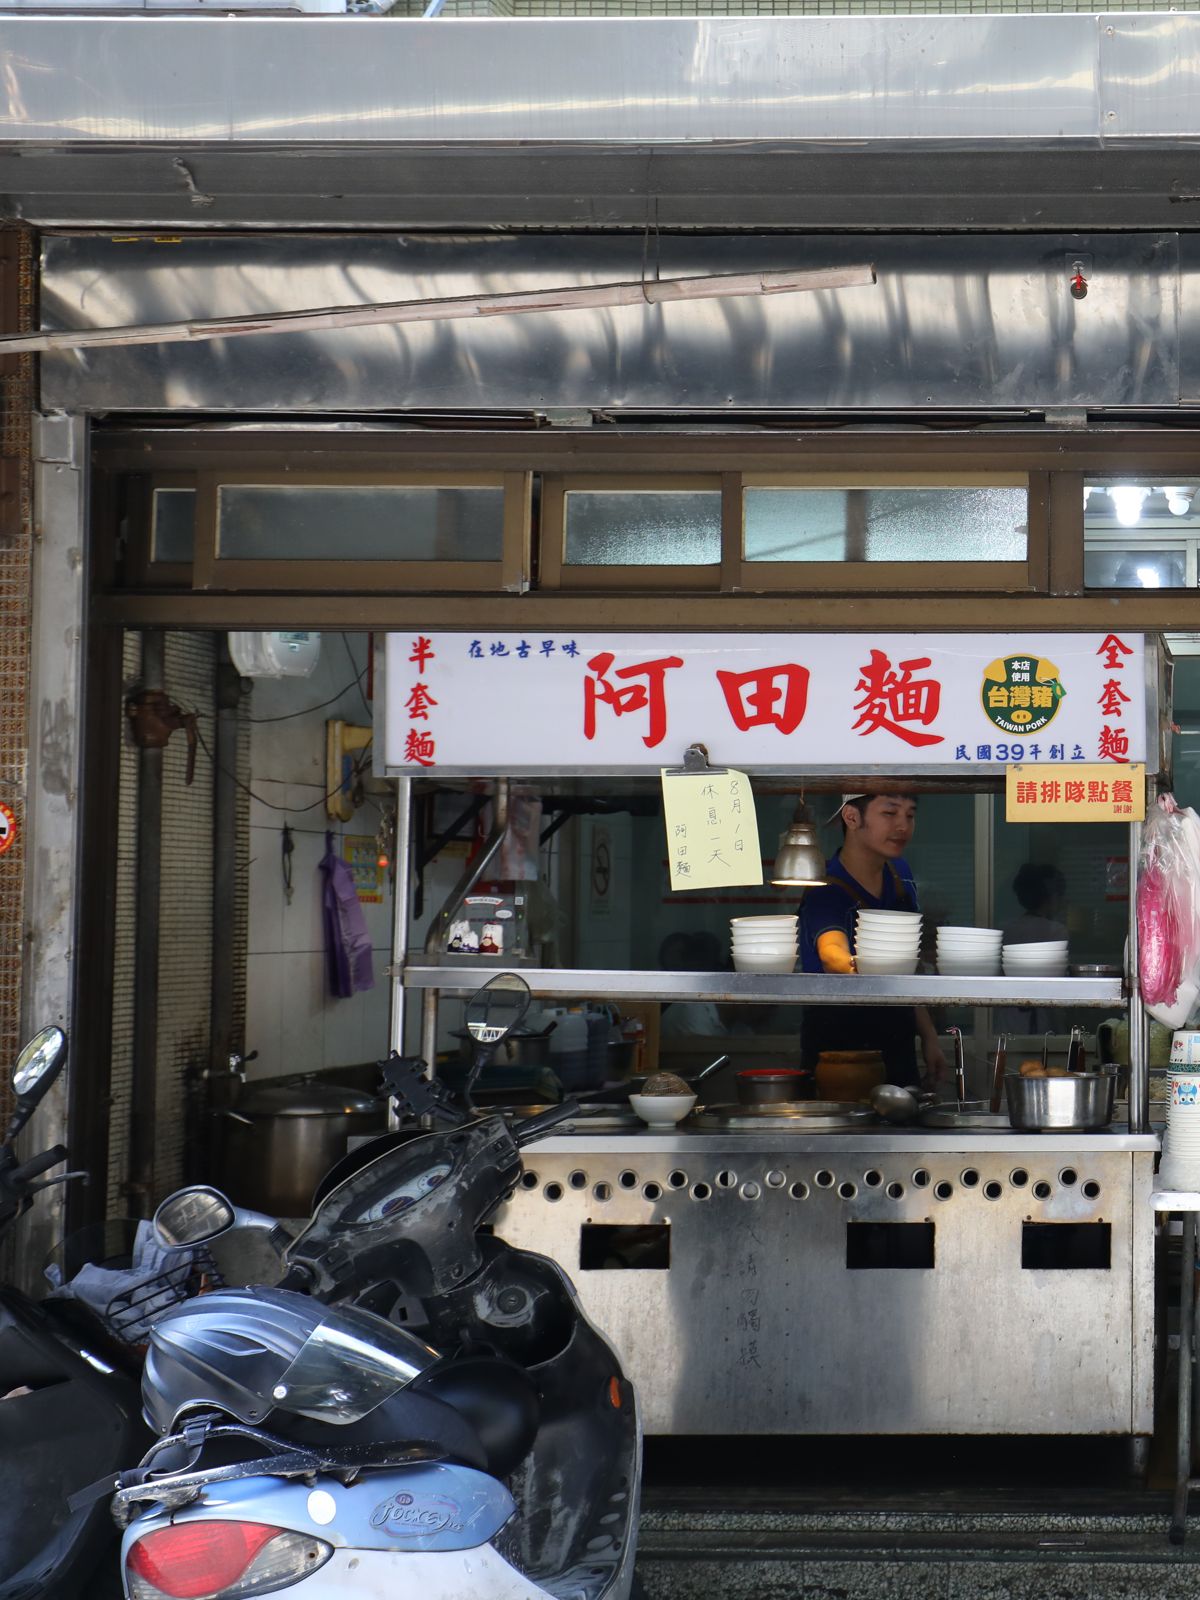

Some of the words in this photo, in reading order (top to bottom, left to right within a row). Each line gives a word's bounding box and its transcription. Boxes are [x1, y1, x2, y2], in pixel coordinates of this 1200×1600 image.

[469, 640, 580, 658] 在地古早味
[1012, 660, 1030, 670] 本店
[1012, 672, 1030, 682] 使用
[404, 636, 438, 767] 半套麵
[584, 649, 944, 748] 阿田麵
[988, 685, 1053, 708] 台灣豬
[1096, 634, 1134, 764] 全套麵
[995, 715, 1024, 732] TAIWAN
[1026, 716, 1048, 732] PORK
[954, 743, 1086, 762] 民國39年創立
[1016, 780, 1134, 804] 請排隊點餐
[701, 783, 732, 868] 休息一天
